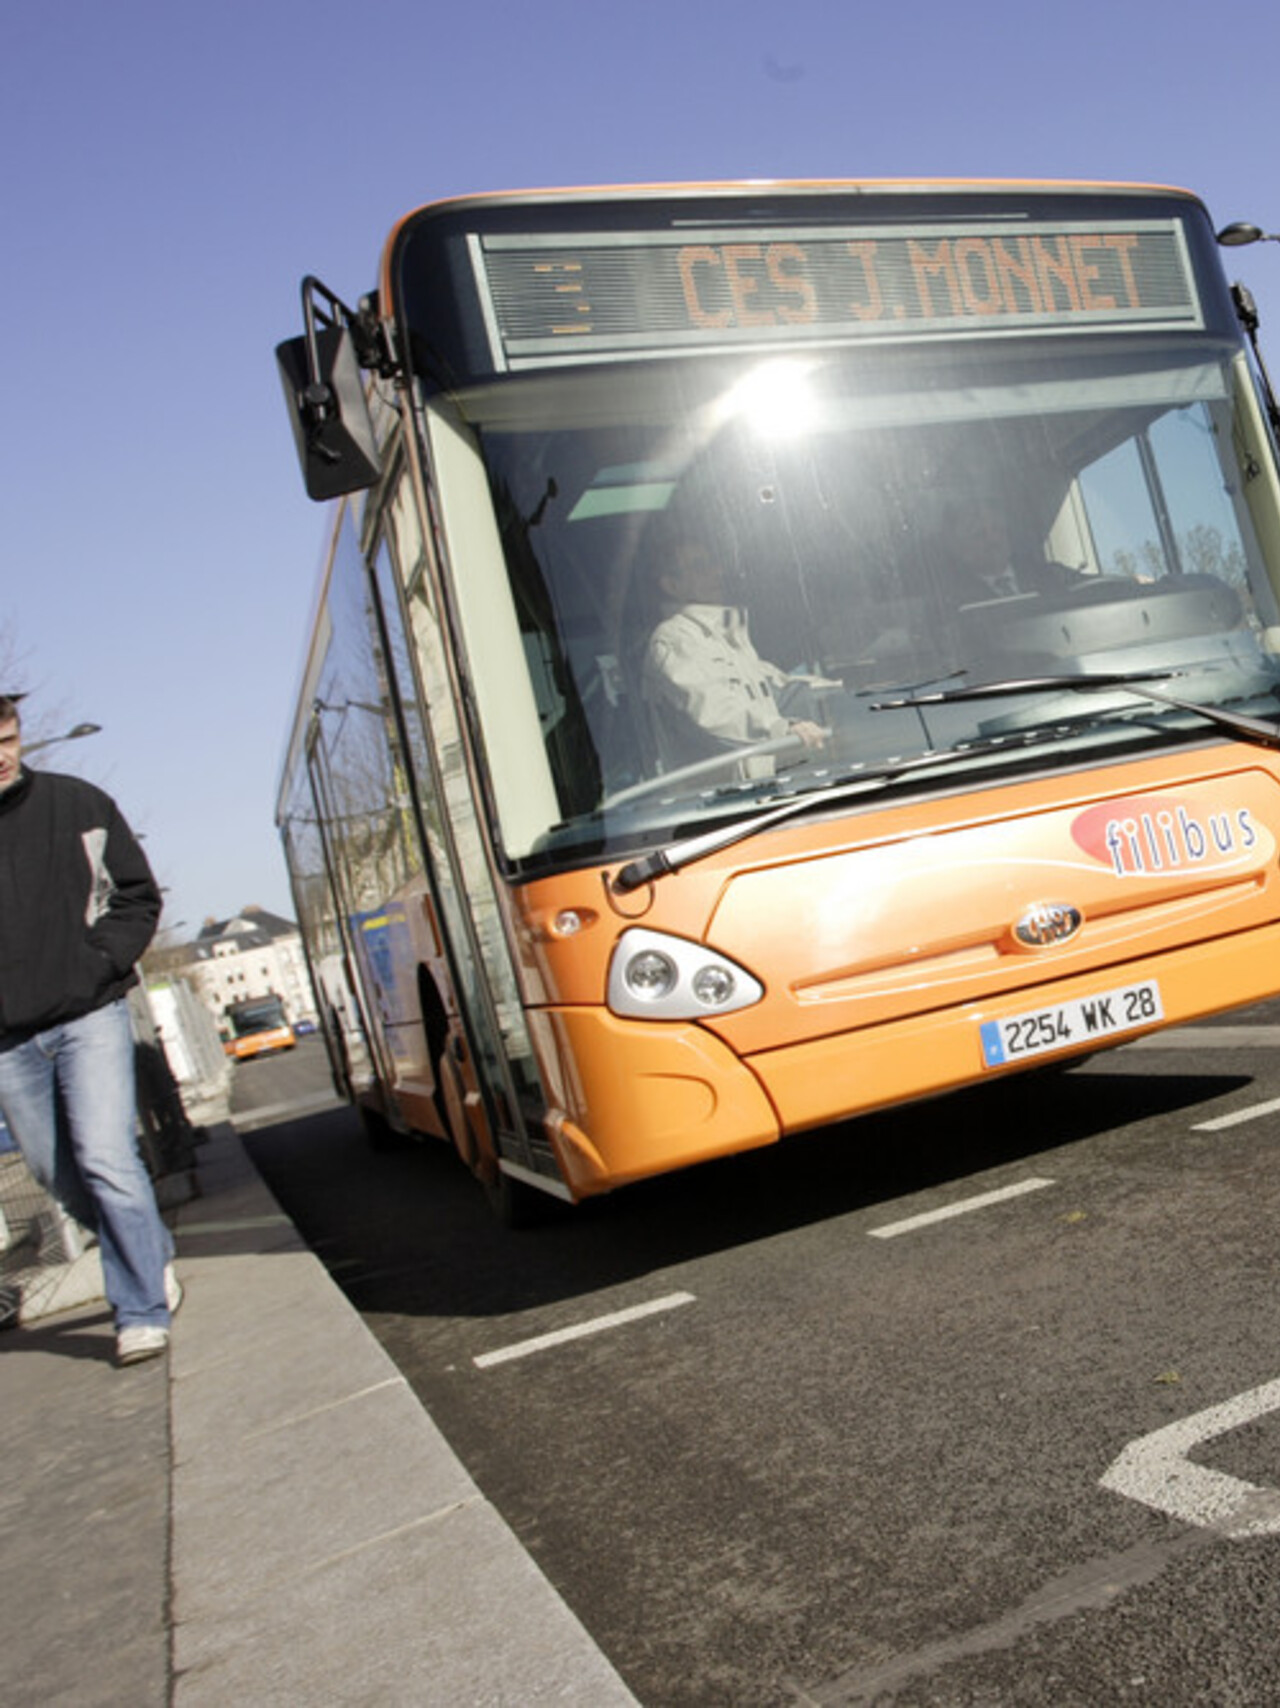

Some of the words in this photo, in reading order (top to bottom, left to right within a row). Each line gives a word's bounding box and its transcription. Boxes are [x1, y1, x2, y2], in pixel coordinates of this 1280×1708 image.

[677, 242, 819, 328] CES
[1105, 805, 1257, 877] filibus
[1005, 1010, 1071, 1053] 2254
[1081, 998, 1116, 1033] WK
[1123, 987, 1156, 1022] 28
